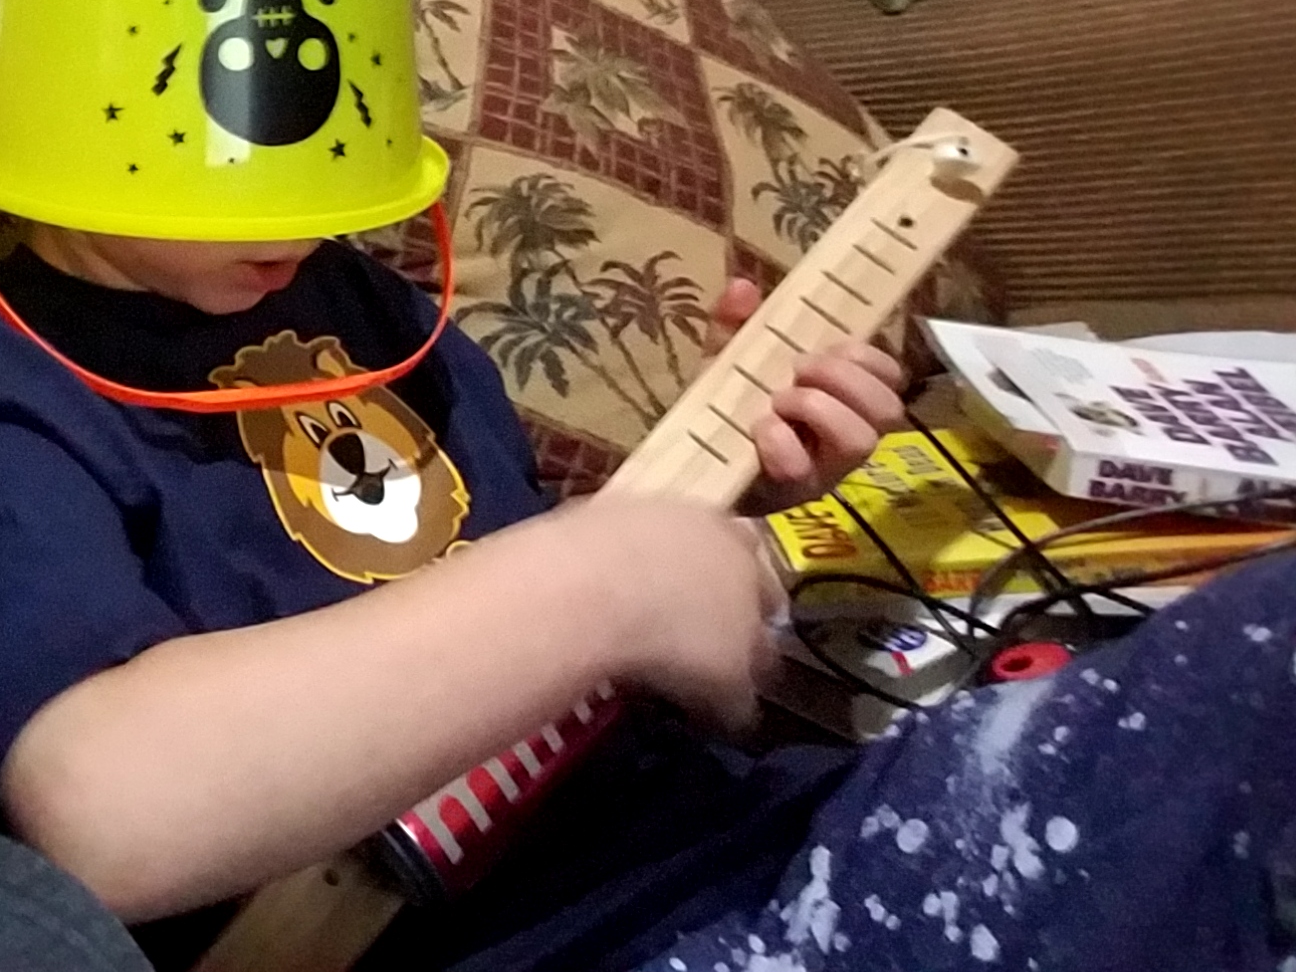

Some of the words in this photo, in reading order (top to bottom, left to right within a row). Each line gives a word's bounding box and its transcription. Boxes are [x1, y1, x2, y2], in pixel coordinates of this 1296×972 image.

[1108, 385, 1212, 446] DAVE
[1147, 382, 1281, 466] BARRY
[1182, 378, 1295, 443] ALAN
[1088, 478, 1189, 506] BARRY
[1098, 459, 1174, 486] DAVE
